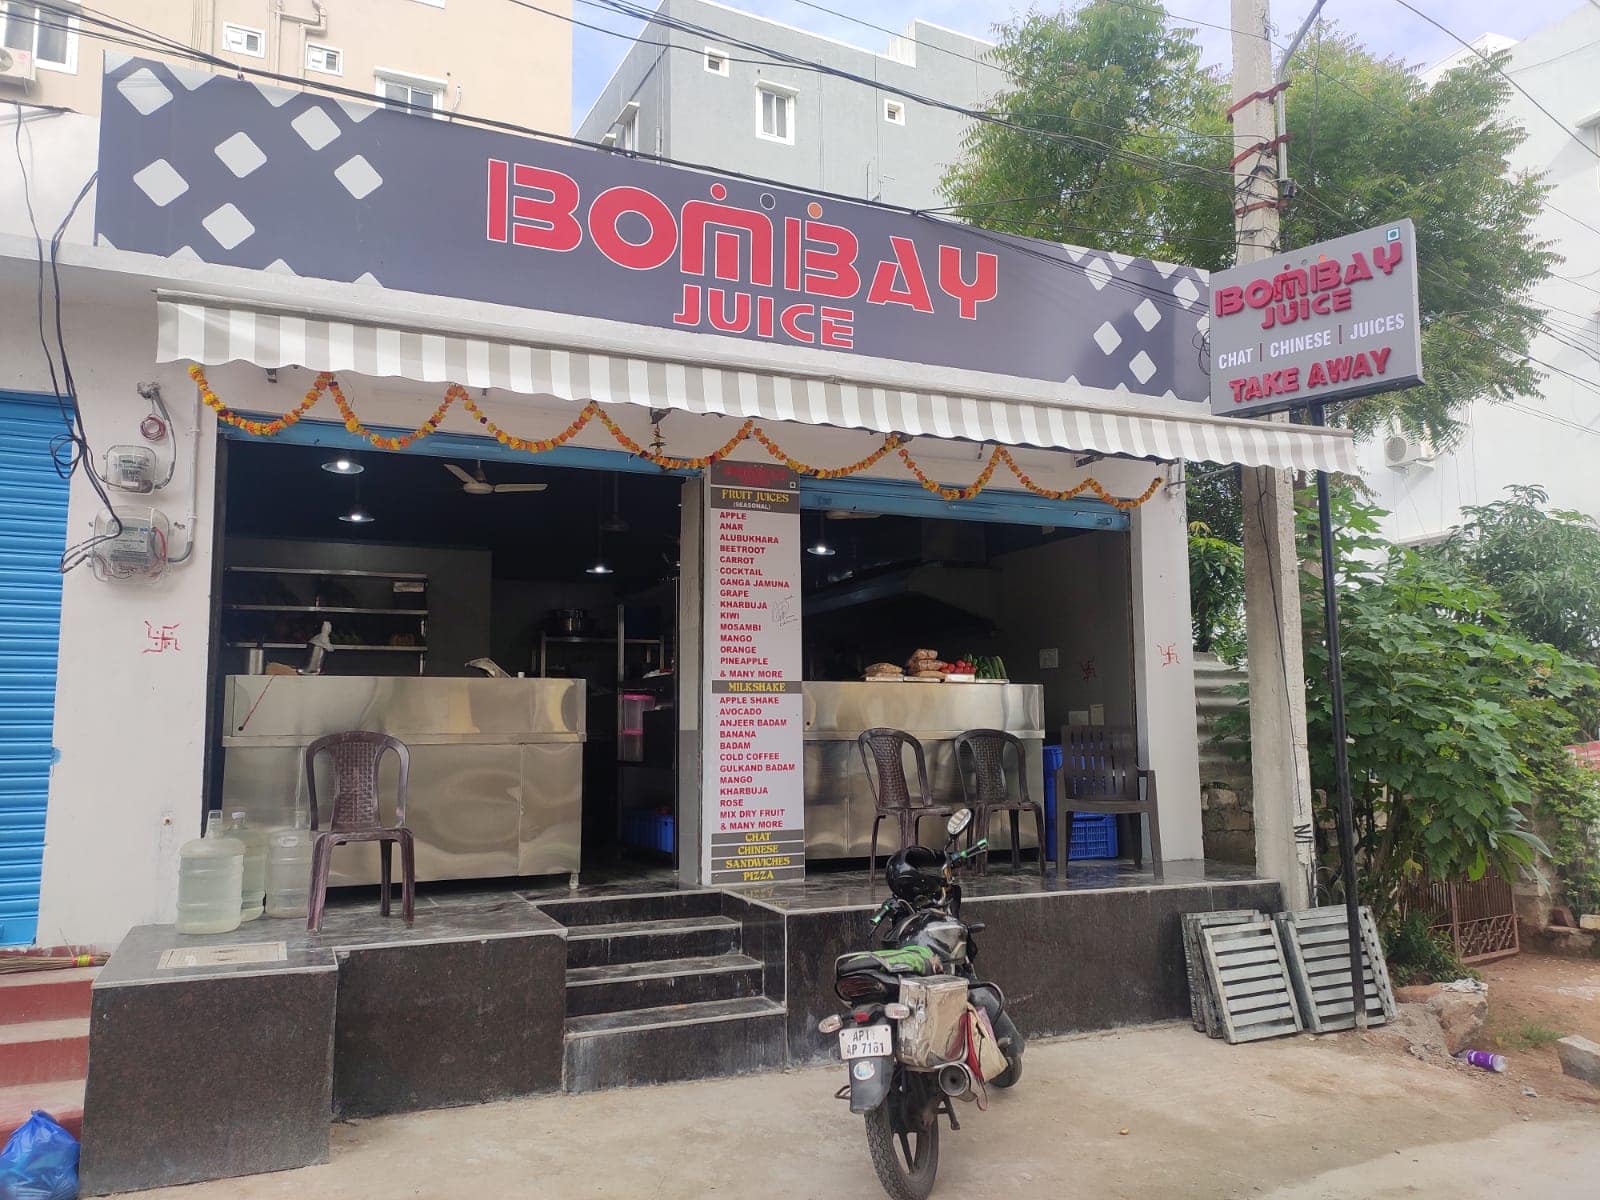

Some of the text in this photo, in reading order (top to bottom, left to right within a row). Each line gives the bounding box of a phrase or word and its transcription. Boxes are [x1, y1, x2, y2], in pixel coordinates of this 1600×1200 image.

[487, 158, 999, 320] BOMBAY
[1215, 242, 1402, 317] BOMBAY
[1262, 288, 1352, 329] JUICE
[673, 284, 854, 349] JUICE
[1219, 313, 1405, 369] CHAT CHINESE JUICES
[1229, 347, 1391, 402] TAKE AWAY
[722, 489, 789, 502] FRUIT JUICES
[734, 502, 770, 510] (SEASONAL)
[720, 512, 746, 520] APPLE
[720, 534, 779, 544] ALUBUKHARA
[720, 545, 765, 554] BEETROOT
[720, 556, 754, 564] CARROT
[720, 567, 763, 576] COCKTAIL
[720, 578, 789, 588] GANGA JAMUNA
[720, 601, 767, 609] KHARBUJA
[728, 682, 785, 691] MILKSHAKE
[720, 787, 768, 795] KHARBUJA
[720, 799, 743, 807] ROSE
[745, 832, 771, 841] CHAT
[738, 845, 779, 854] CHINESE
[726, 857, 791, 868] SANDWICHES
[743, 871, 773, 880] PIZZA
